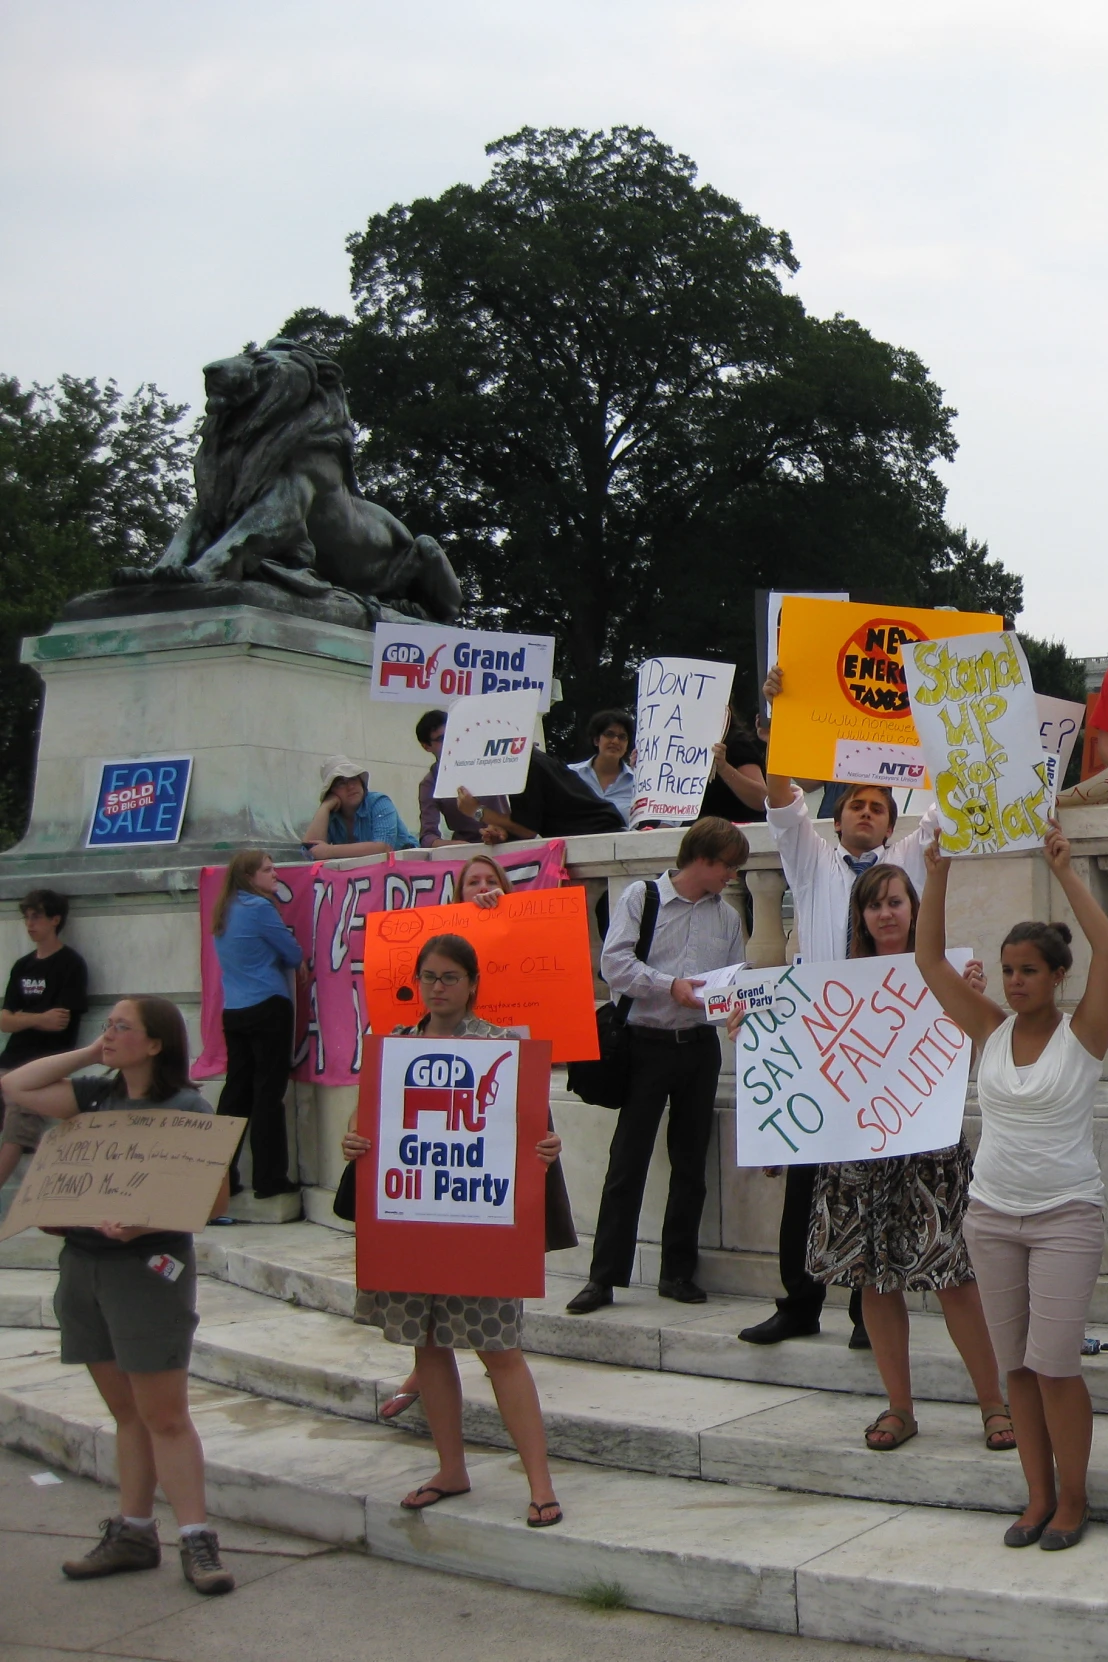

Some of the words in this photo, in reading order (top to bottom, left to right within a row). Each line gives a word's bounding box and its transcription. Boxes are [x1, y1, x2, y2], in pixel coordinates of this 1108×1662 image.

[386, 645, 421, 662] GOP
[453, 642, 526, 671] Grand
[440, 668, 472, 695] Oil
[646, 659, 716, 700] DON'T
[913, 632, 1026, 706] Stand
[637, 703, 661, 733] ET
[664, 704, 682, 731] A
[483, 736, 527, 756] NTU
[665, 735, 707, 767] FROM
[110, 767, 177, 796] FOR
[656, 762, 707, 795] PRICES
[878, 762, 925, 777] NTU
[106, 805, 119, 815] TO
[121, 801, 136, 811] BIG
[139, 797, 153, 807] OIL
[107, 784, 154, 805] SOLD
[95, 803, 177, 835] SALE
[508, 897, 579, 919] WALLETS
[486, 960, 509, 975] Our
[520, 955, 565, 974] OIL
[736, 984, 764, 999] Grand
[750, 994, 773, 1009] Party
[743, 1036, 803, 1105] SAY
[801, 979, 856, 1052] NO
[412, 1059, 466, 1086] GOP
[757, 1092, 825, 1153] TO
[819, 967, 929, 1103] FALSE
[856, 1009, 966, 1152] SOLUTIO
[54, 1139, 104, 1163] SUPPLY
[399, 1134, 485, 1167] Grand
[385, 1168, 422, 1200] Oil
[434, 1170, 509, 1207] Party
